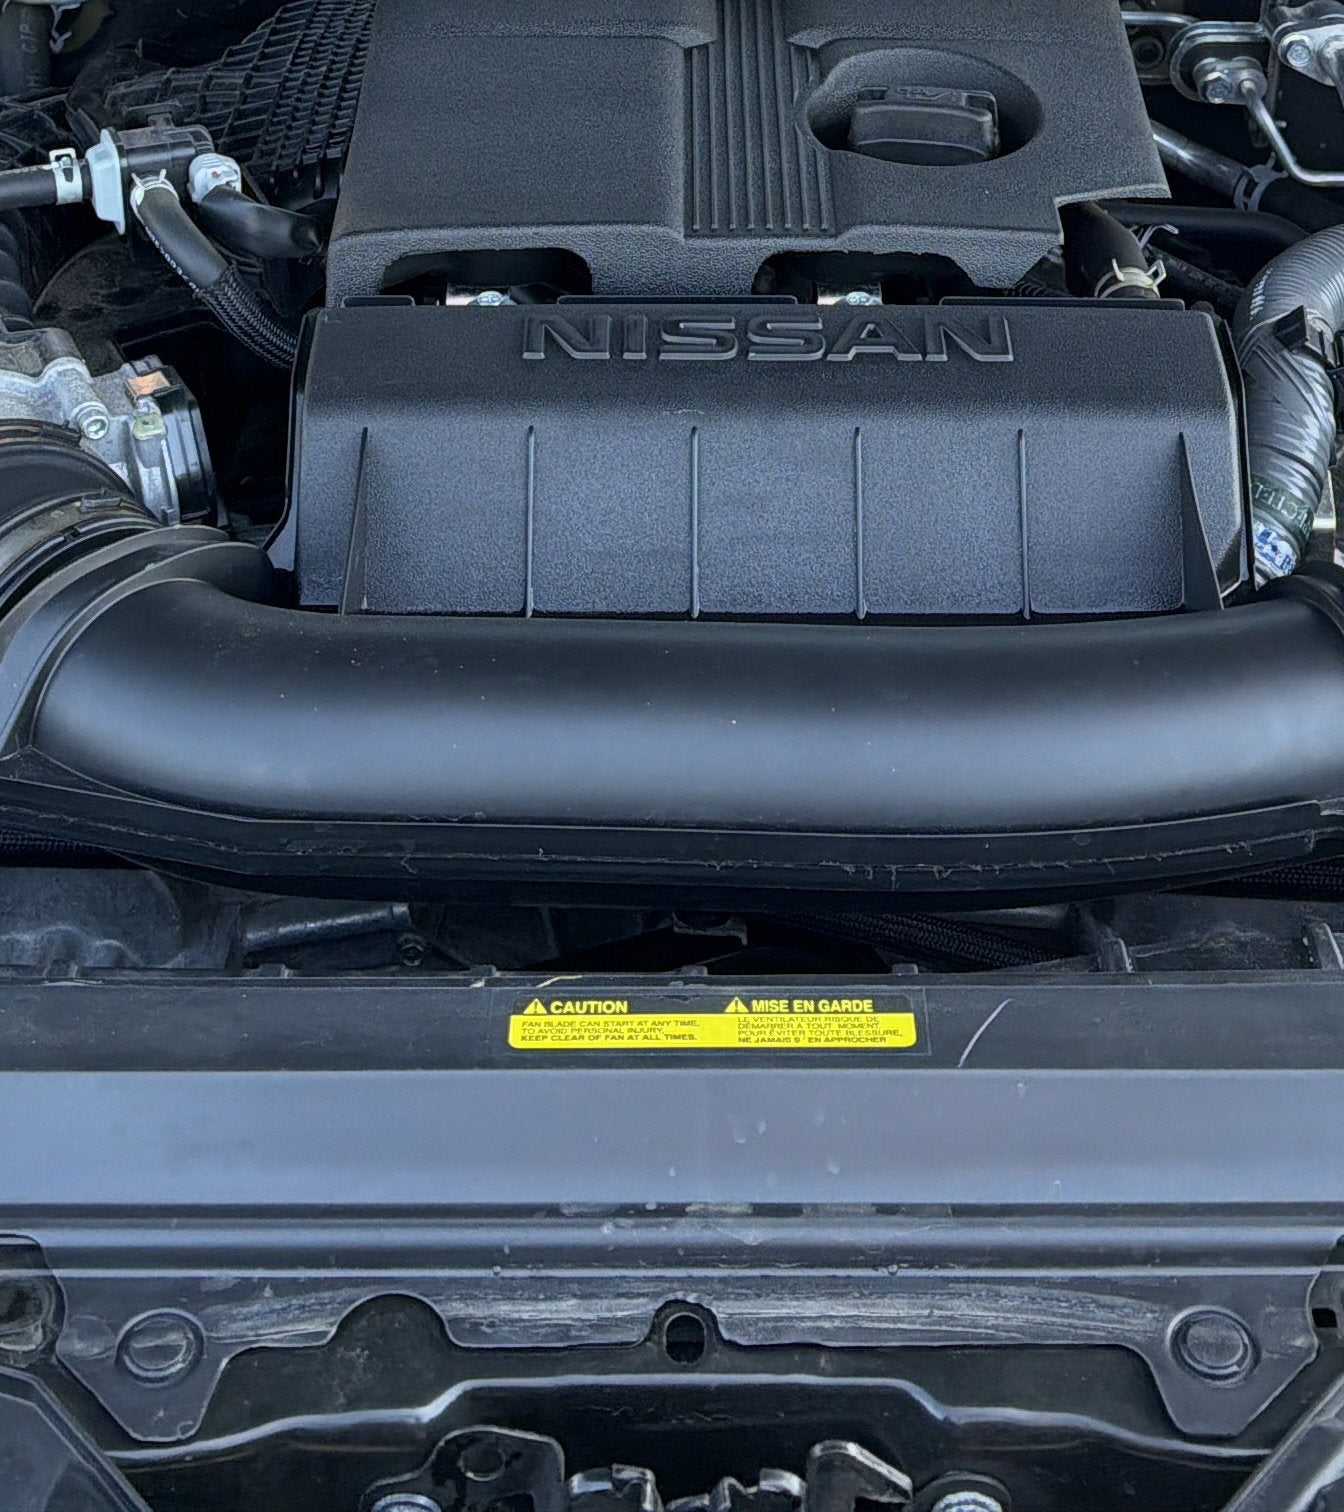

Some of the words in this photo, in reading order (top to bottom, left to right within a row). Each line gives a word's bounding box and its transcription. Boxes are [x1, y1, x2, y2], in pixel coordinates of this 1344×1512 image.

[522, 314, 1015, 363] NISSAN
[550, 1000, 628, 1014] CAUTION
[752, 999, 789, 1013] MISE
[794, 999, 815, 1013] EN
[818, 999, 874, 1013] GARDE
